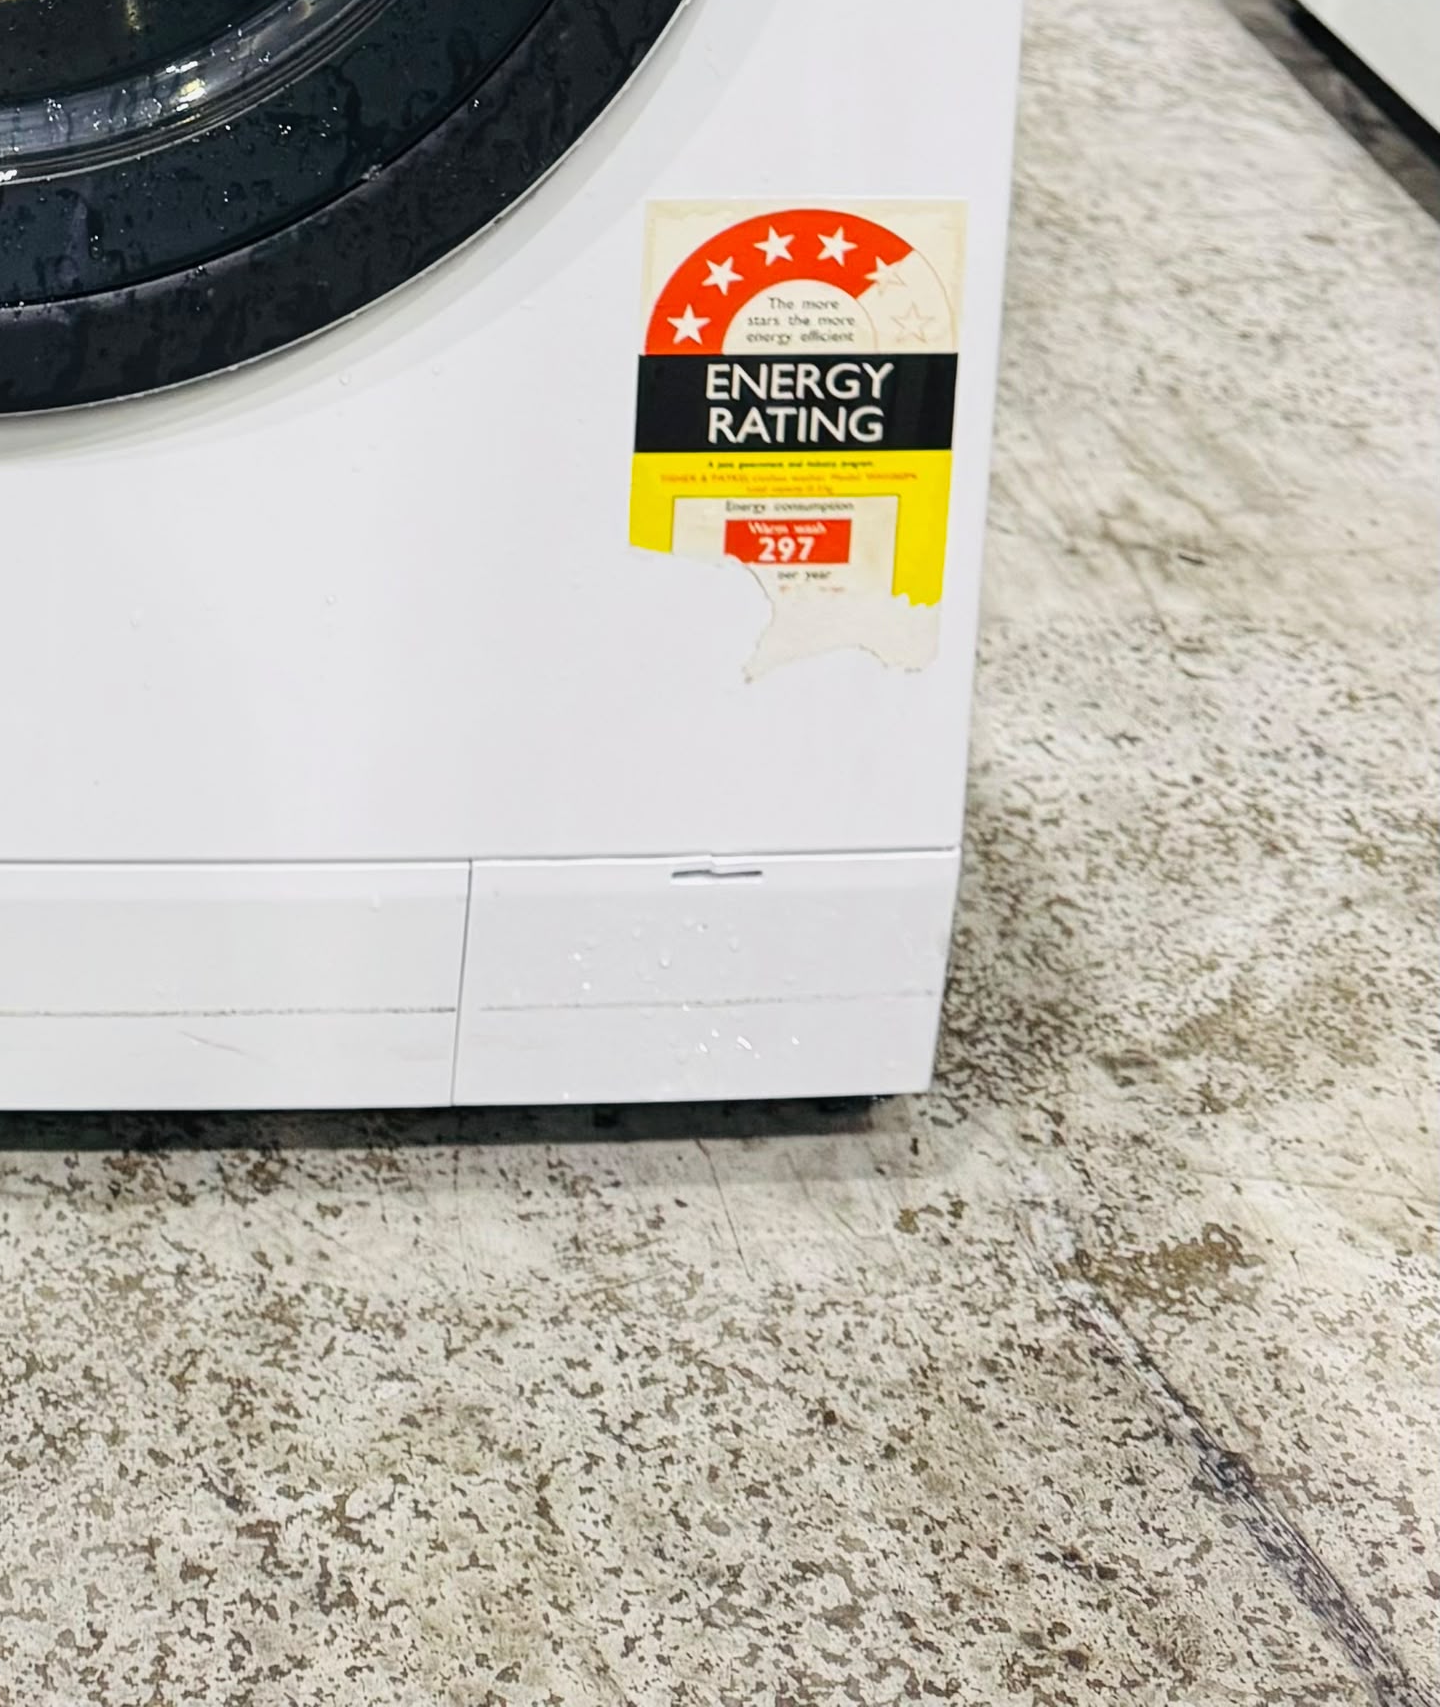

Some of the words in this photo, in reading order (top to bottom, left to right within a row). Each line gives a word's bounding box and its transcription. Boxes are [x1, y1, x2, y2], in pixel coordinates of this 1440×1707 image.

[768, 297, 794, 309] The
[802, 301, 839, 309] more
[747, 317, 780, 325] stars
[789, 315, 810, 325] the
[818, 317, 855, 325] more
[746, 334, 790, 345] energy
[801, 331, 854, 342] efficient
[705, 363, 895, 400] ENERGY
[708, 407, 884, 443] RATING
[726, 501, 766, 513] Energy
[758, 537, 814, 561] 297
